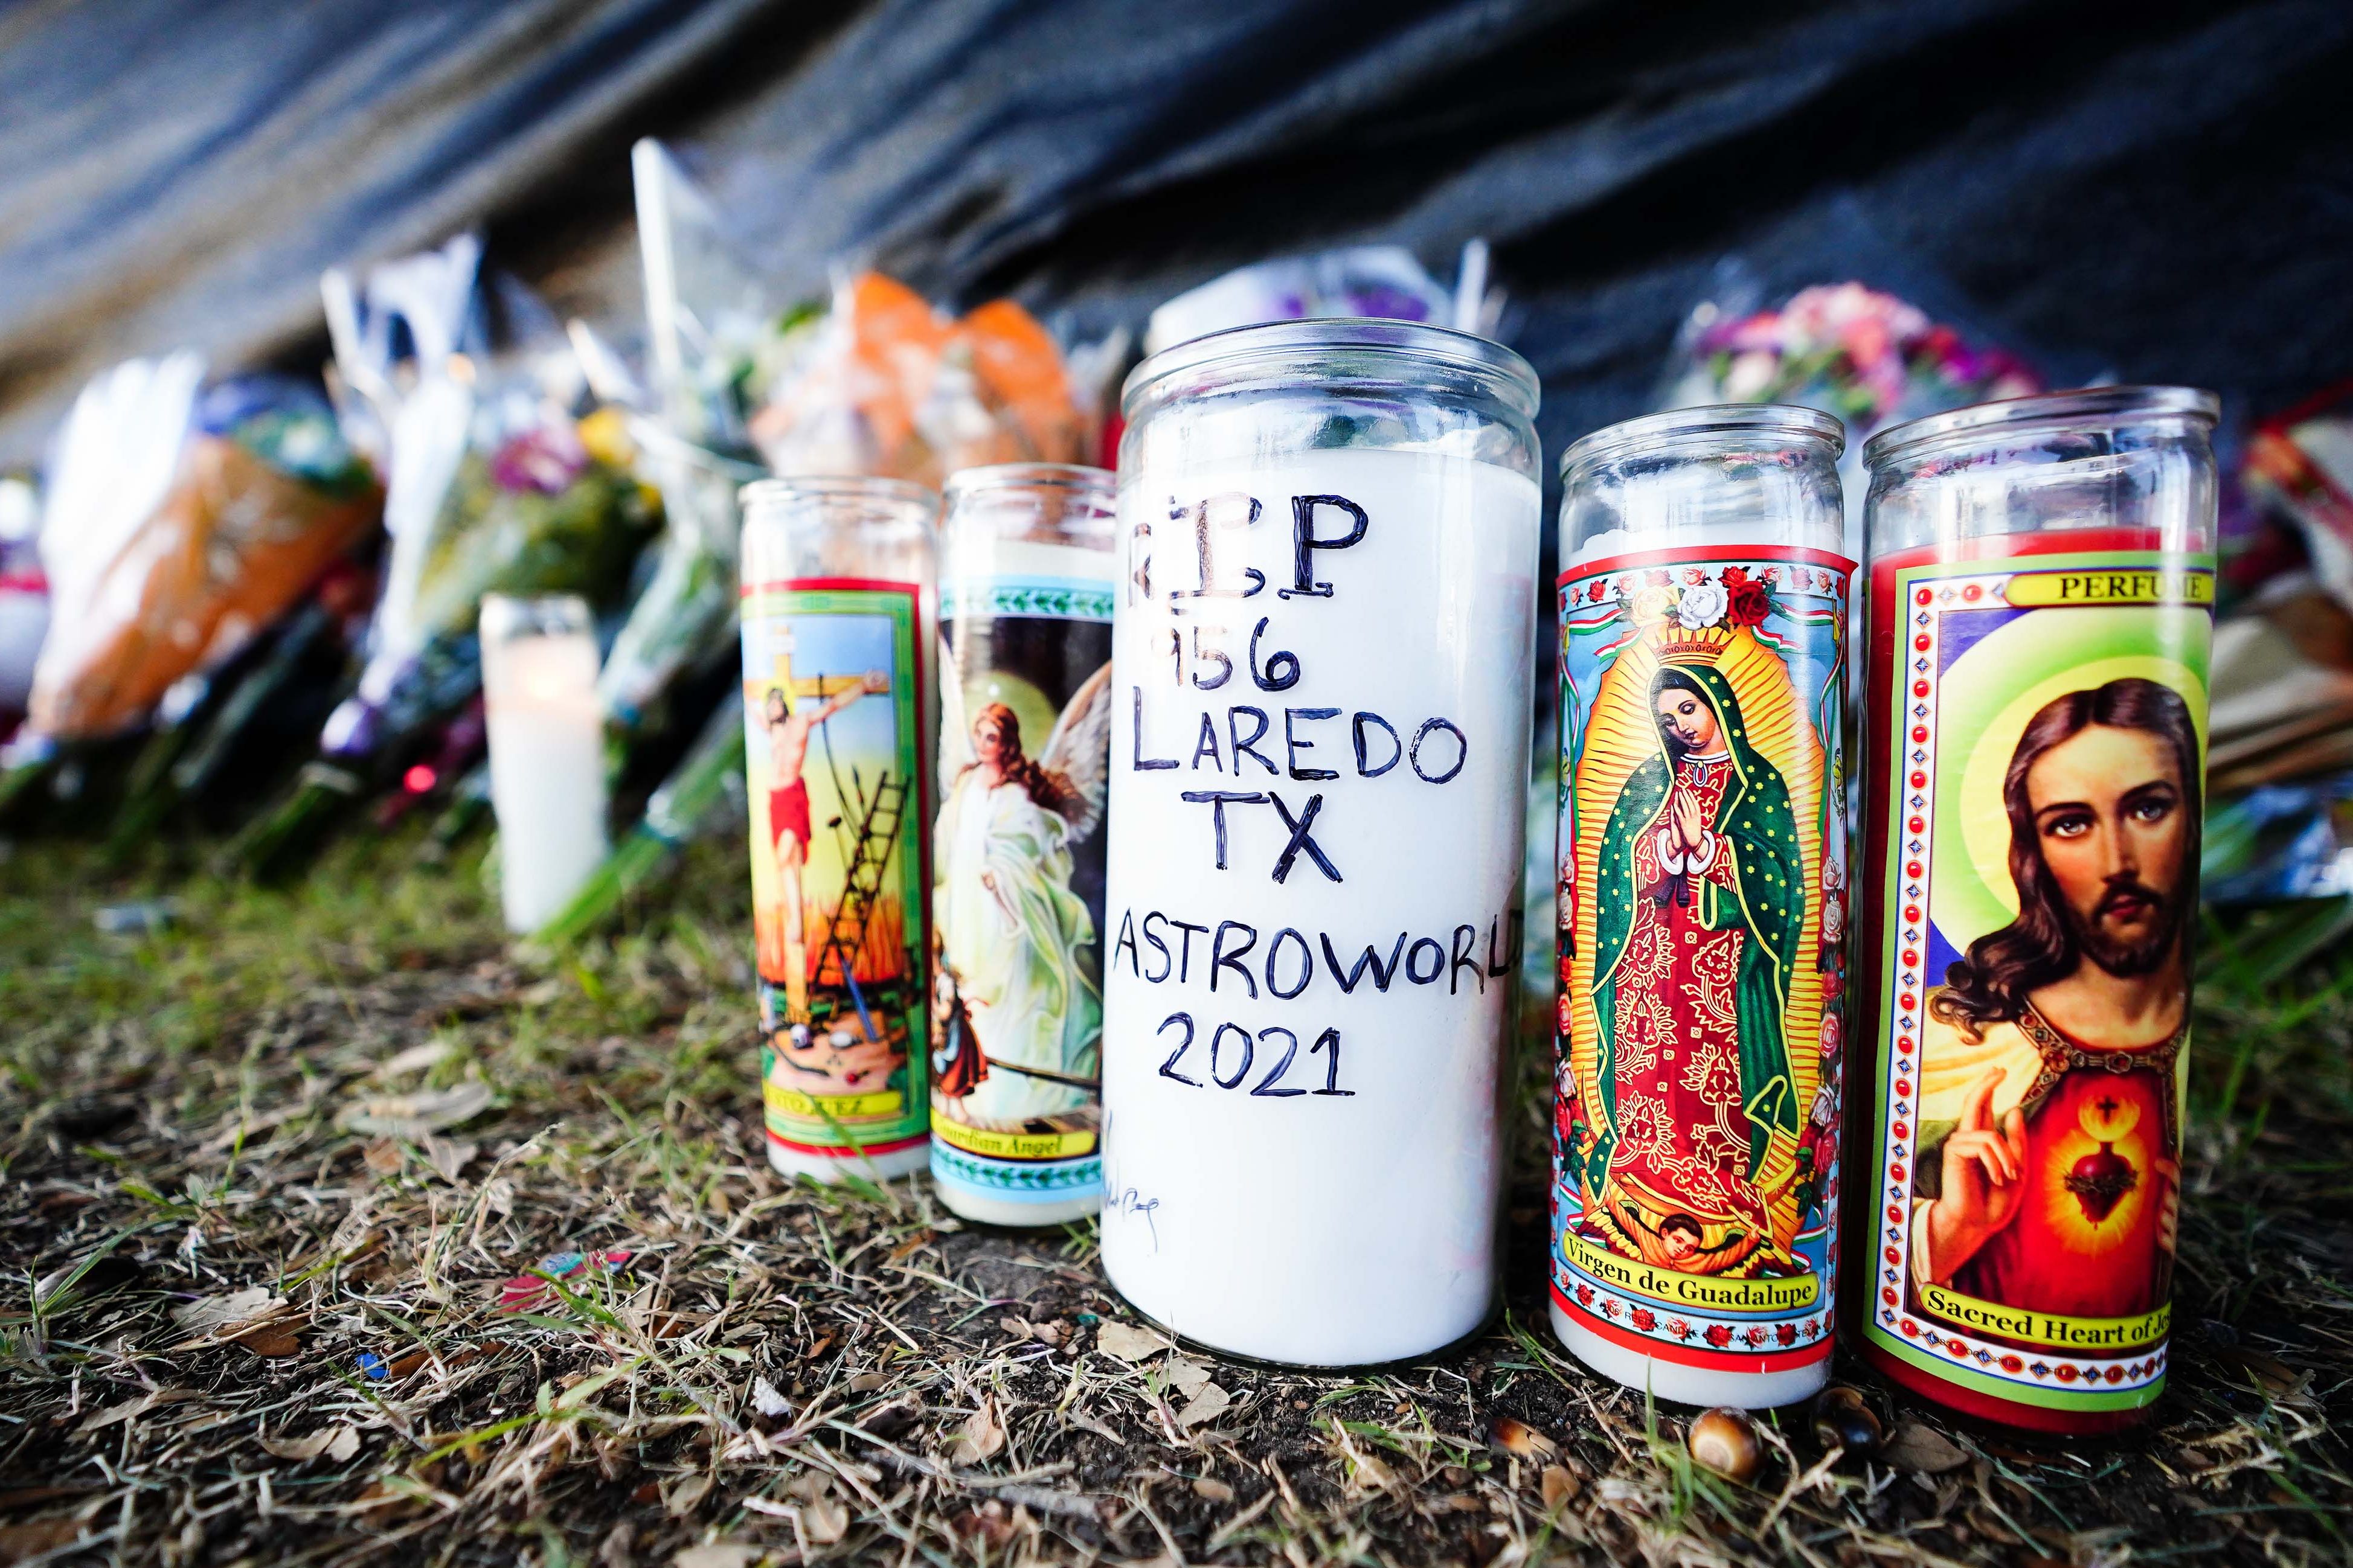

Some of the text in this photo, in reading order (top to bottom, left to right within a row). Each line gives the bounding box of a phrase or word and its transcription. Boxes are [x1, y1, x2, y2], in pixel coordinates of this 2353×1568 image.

[2060, 575, 2202, 599] PERFUE
[1133, 686, 1467, 784] LAREDO
[1181, 791, 1343, 884] TX
[1157, 1012, 1356, 1096] 2021
[1007, 1134, 1062, 1157] Angel
[1567, 1237, 1812, 1309] Virgen de Guadalupe
[1656, 1321, 1700, 1339] CANDE
[1928, 1290, 2032, 1336] Sacred
[2044, 1320, 2125, 1344] Heart
[2131, 1316, 2153, 1341] of
